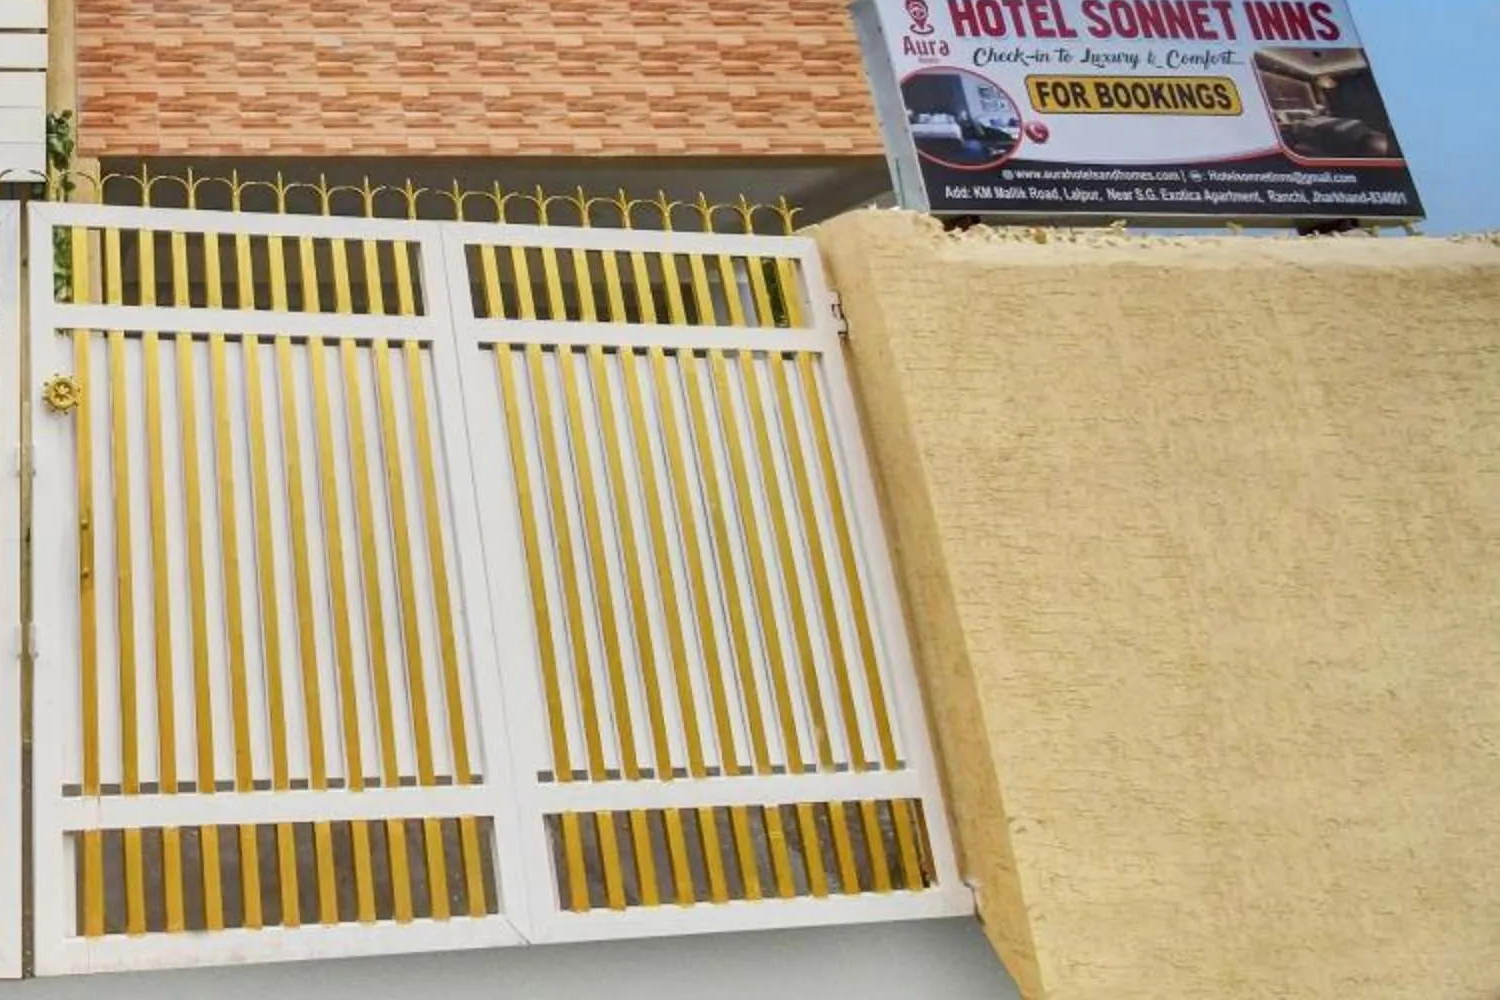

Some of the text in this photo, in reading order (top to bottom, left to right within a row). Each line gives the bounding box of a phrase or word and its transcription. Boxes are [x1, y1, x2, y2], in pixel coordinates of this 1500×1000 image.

[1242, 1, 1340, 41] INNS
[903, 36, 949, 57] Aura
[972, 47, 1050, 68] Check-in
[1057, 47, 1074, 63] to
[1079, 47, 1140, 70] Luxury
[1166, 48, 1245, 67] Comfort
[1037, 81, 1232, 111] FOR BOOKINGS
